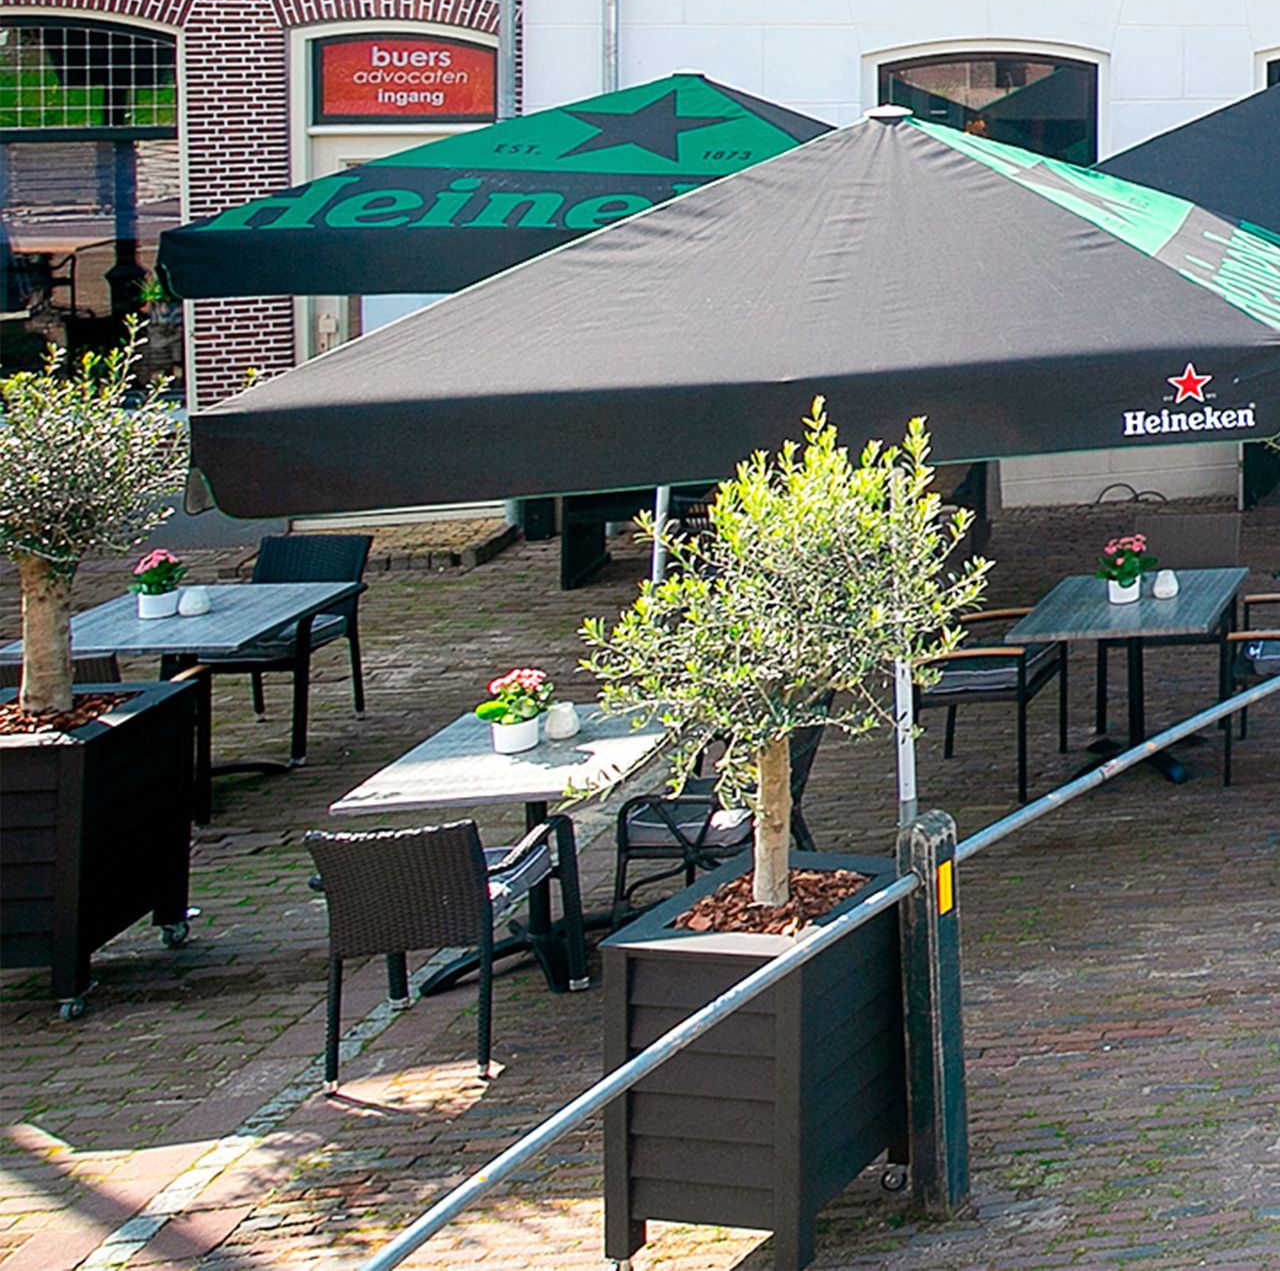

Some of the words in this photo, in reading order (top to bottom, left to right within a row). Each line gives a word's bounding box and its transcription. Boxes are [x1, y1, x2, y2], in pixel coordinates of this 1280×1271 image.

[371, 46, 452, 67] buers
[353, 69, 468, 84] advocaten
[378, 88, 444, 106] ingang
[495, 143, 541, 156] EST.
[702, 149, 754, 162] 1873
[202, 176, 700, 230] Heine
[1123, 404, 1255, 436] Heineken
